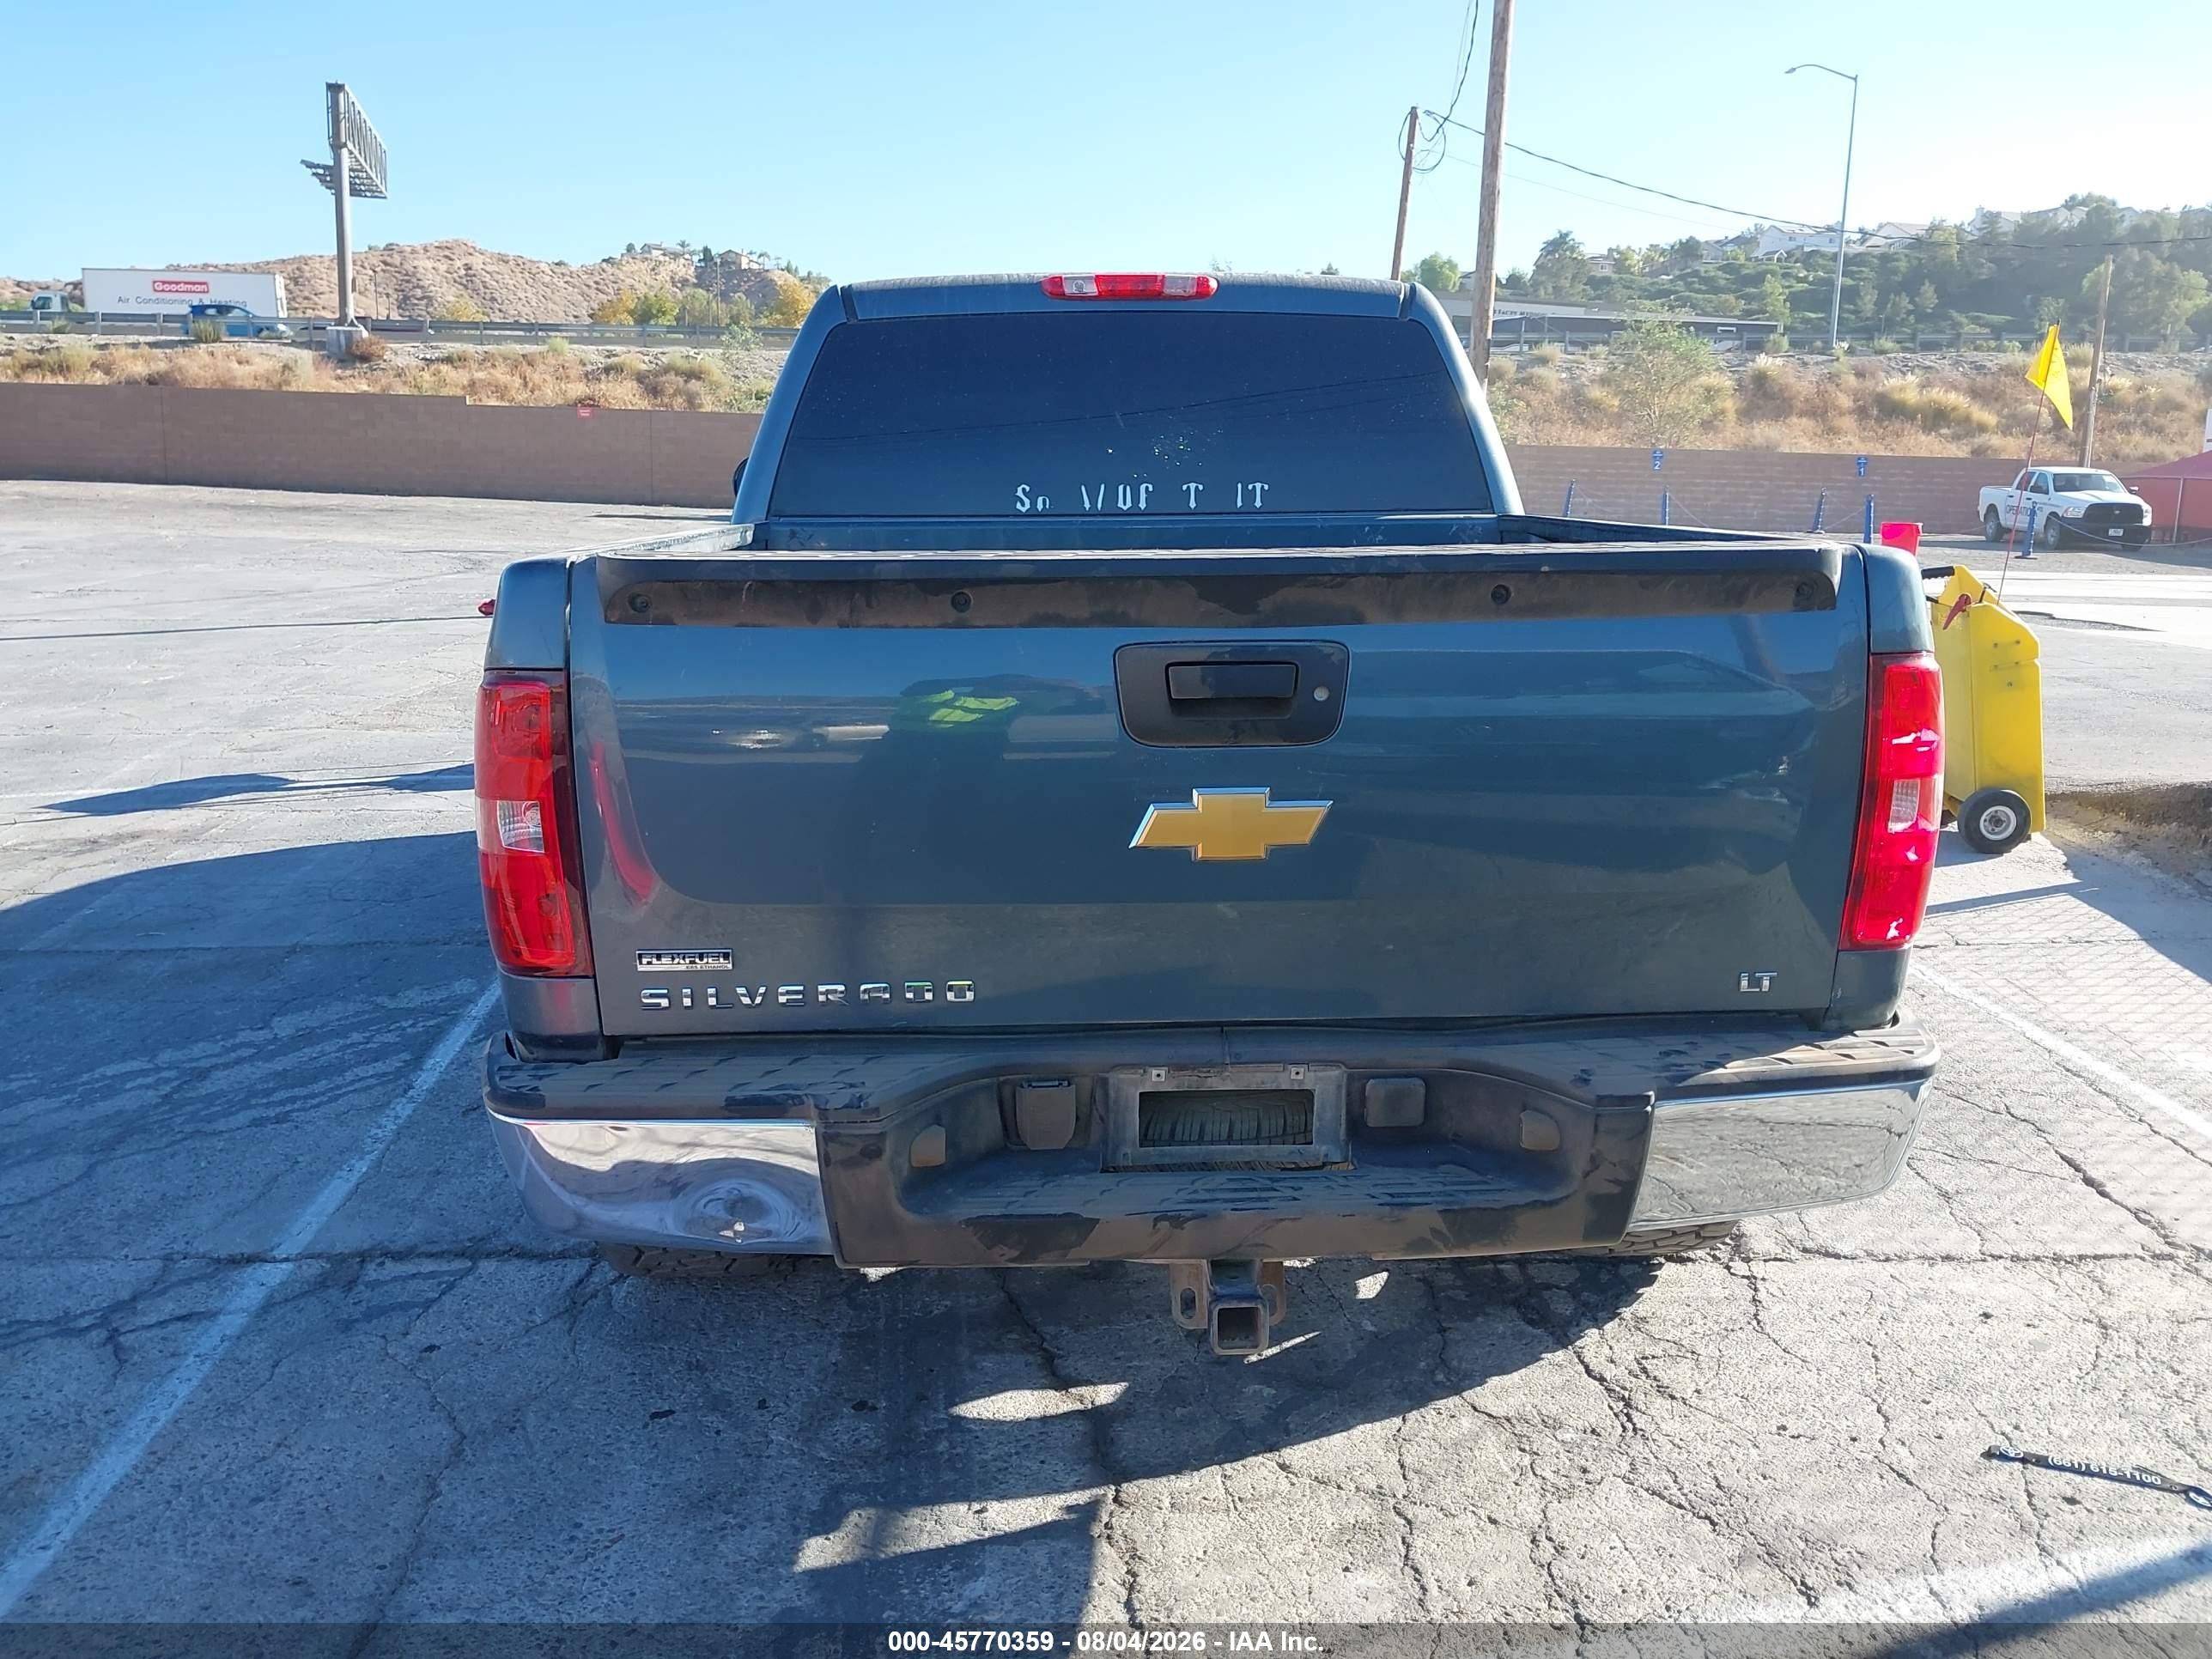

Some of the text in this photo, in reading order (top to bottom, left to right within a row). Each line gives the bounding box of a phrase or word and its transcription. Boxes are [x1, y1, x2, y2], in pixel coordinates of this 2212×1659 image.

[154, 282, 209, 293] Goodman
[136, 296, 193, 307] Conditioning
[210, 298, 247, 307] Heating
[1654, 460, 1662, 470] 2
[1860, 467, 1864, 476] 1
[641, 952, 730, 964] FLEXFUEL
[1740, 971, 1778, 992] LT
[641, 980, 975, 1009] SILVERADO
[2048, 1455, 2161, 1485] (661) 615-1100
